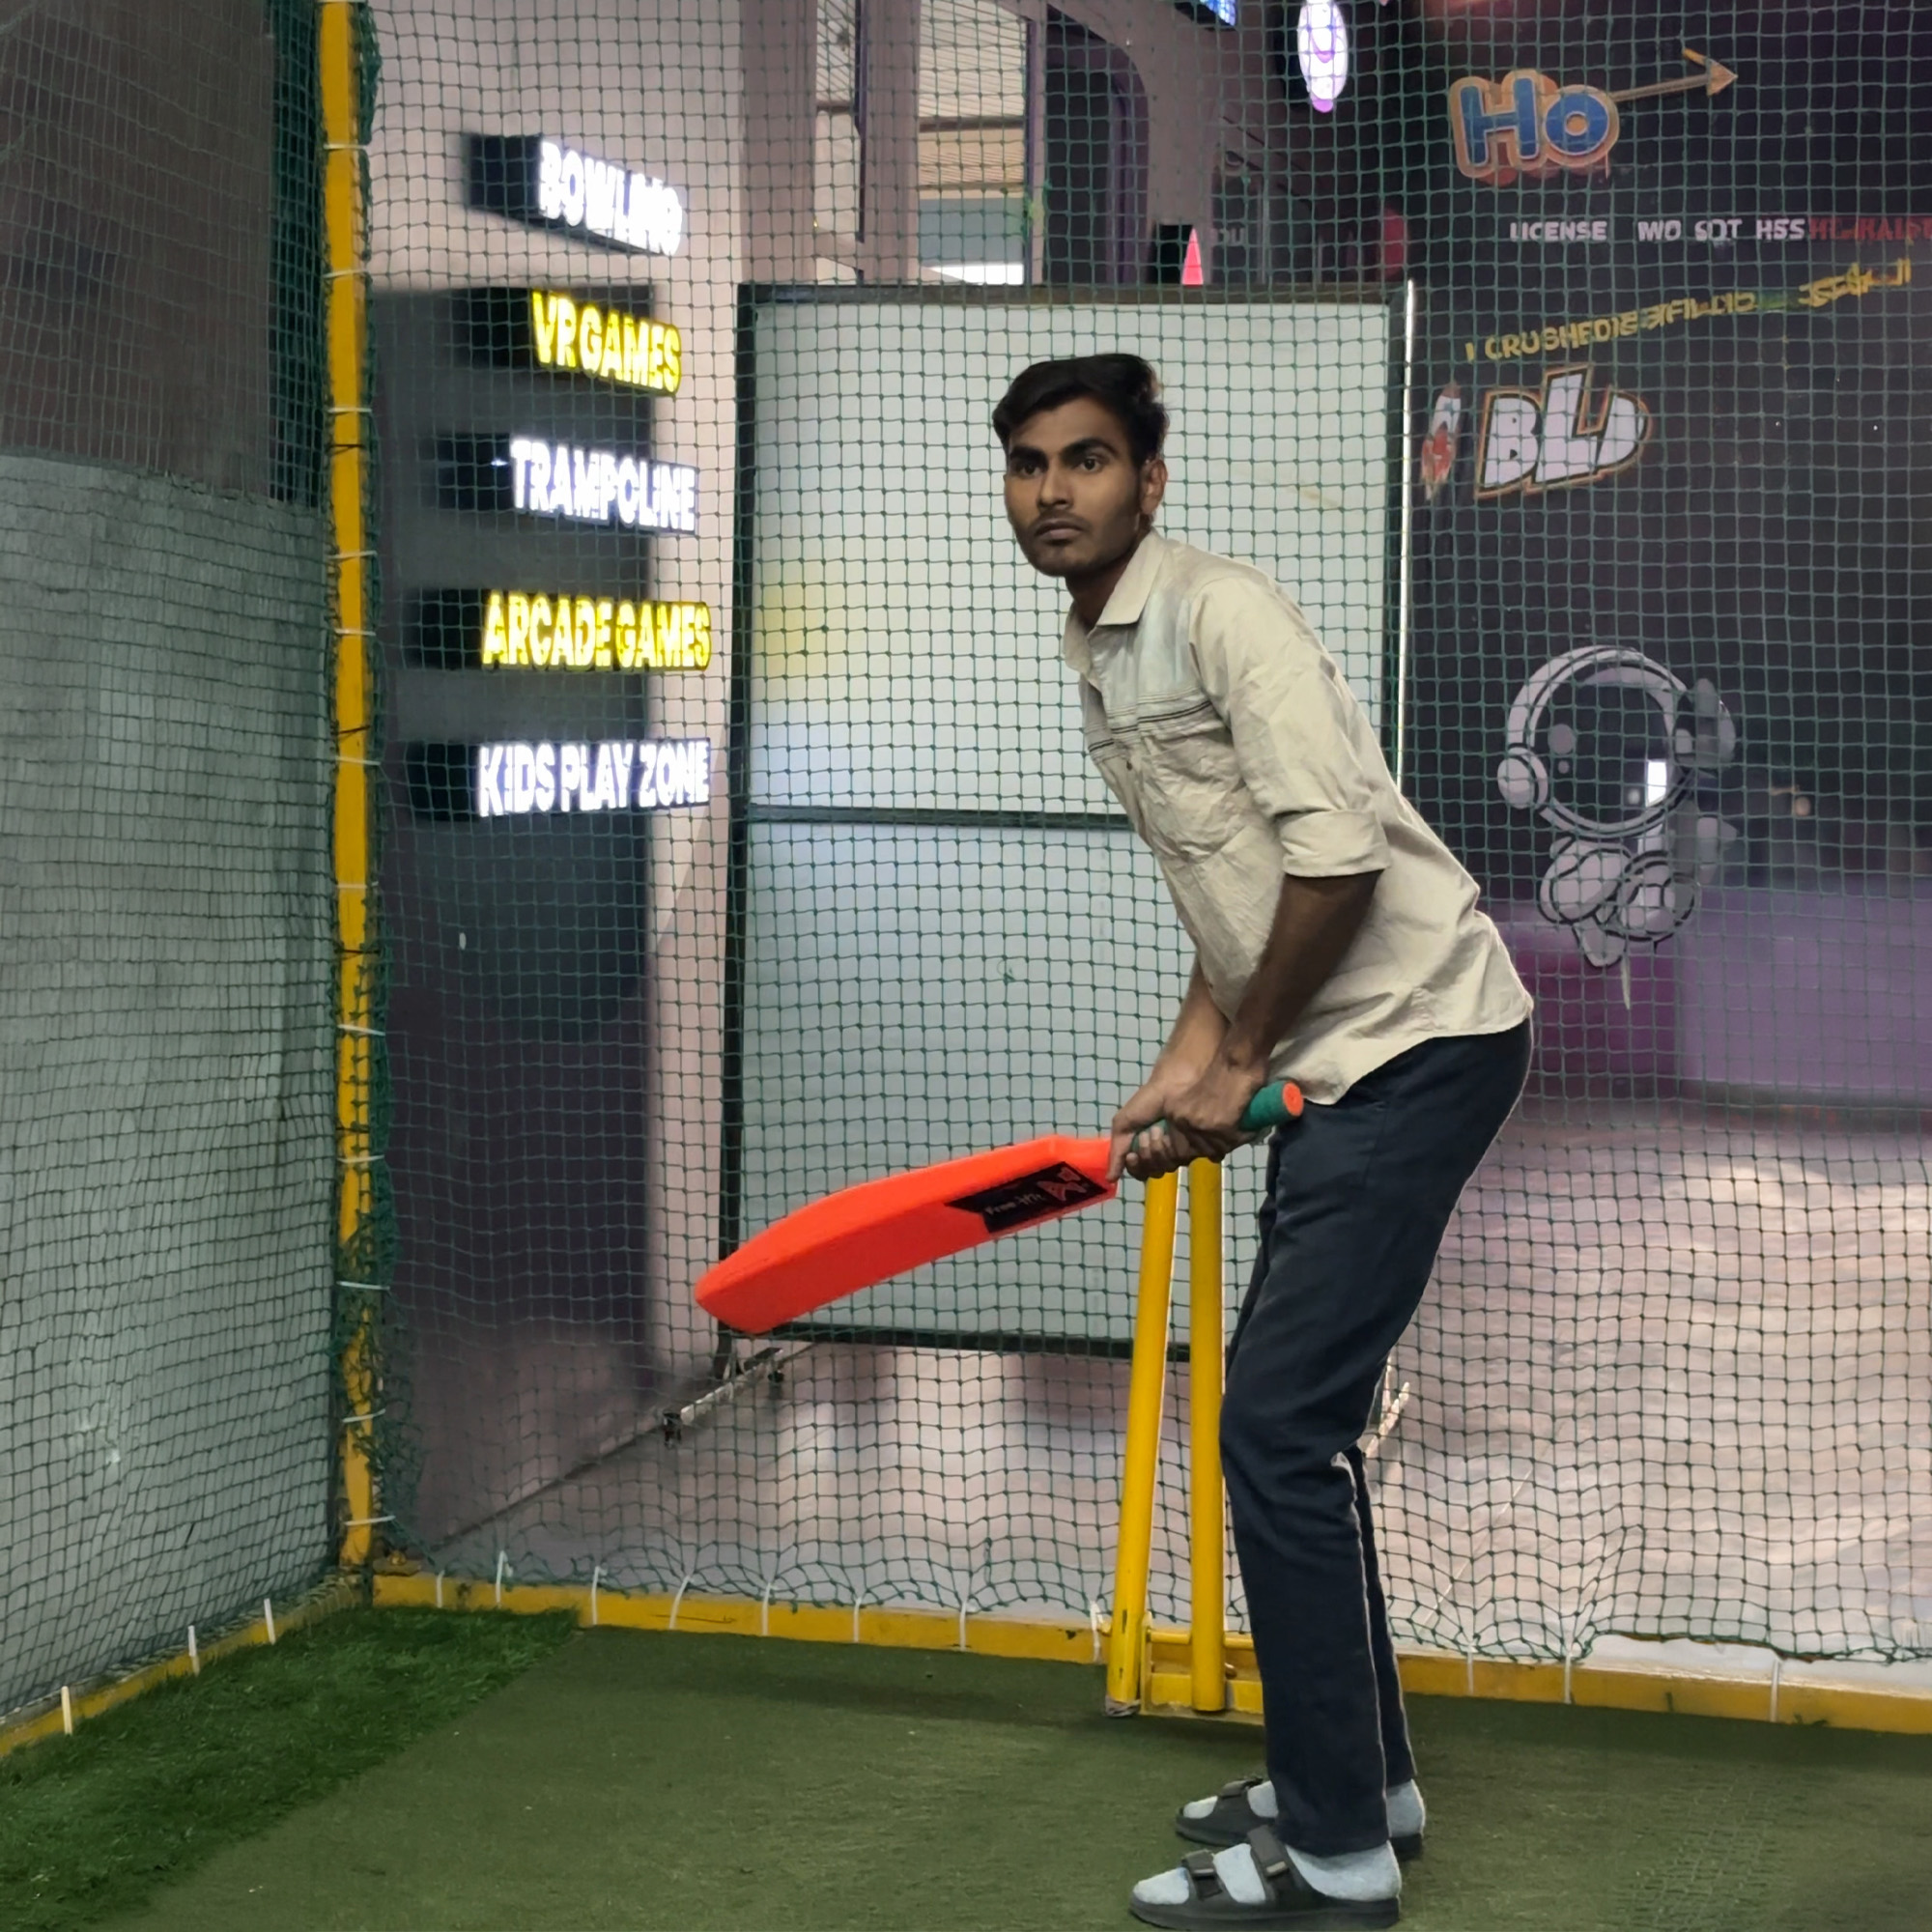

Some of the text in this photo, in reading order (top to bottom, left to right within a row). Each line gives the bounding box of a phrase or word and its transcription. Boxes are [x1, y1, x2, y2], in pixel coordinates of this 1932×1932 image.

[1510, 221, 1607, 242] LICENSE
[532, 291, 680, 393] VR GAMES
[510, 440, 696, 531] TRAMPOLINE
[483, 592, 711, 669] ARCADE GAMES
[479, 740, 710, 817] KIDS PLAY ZONE
